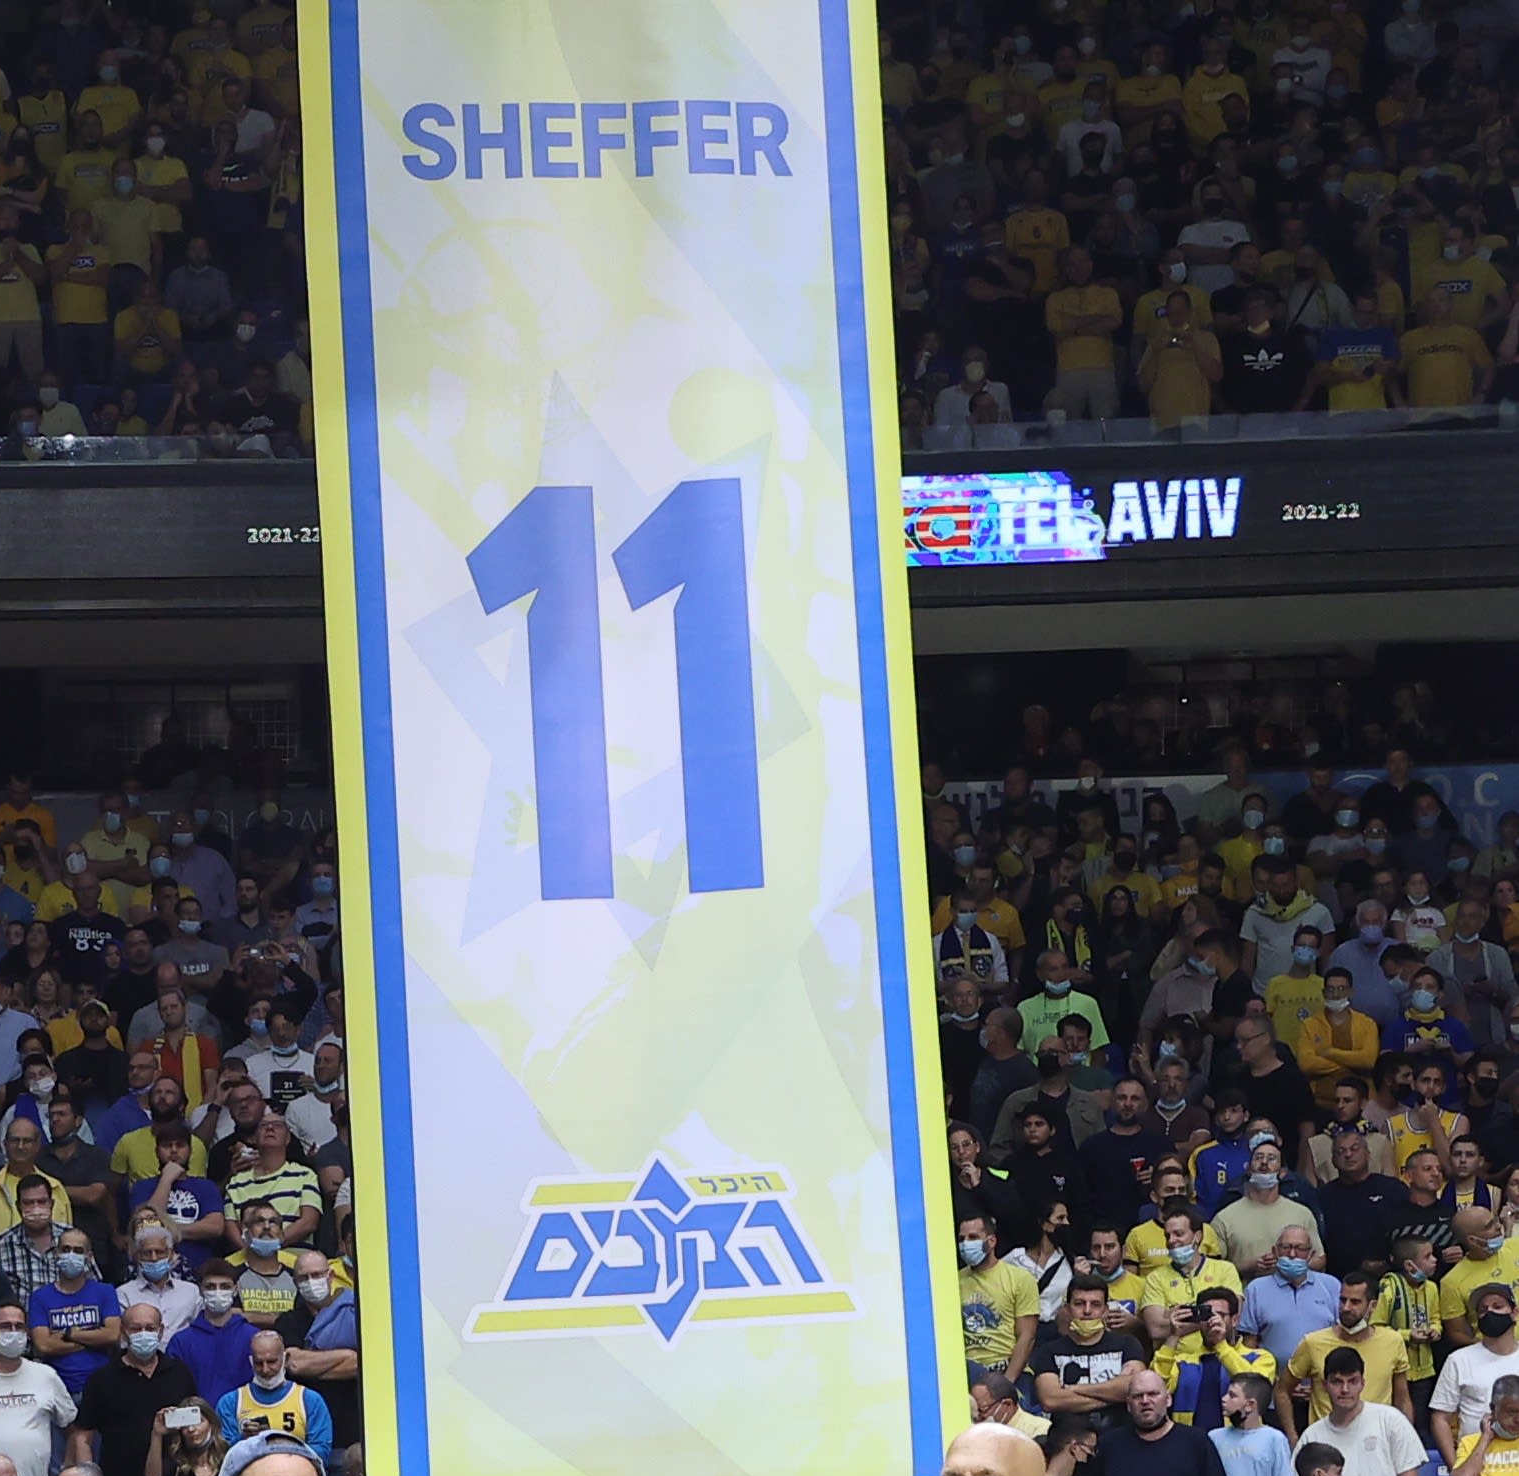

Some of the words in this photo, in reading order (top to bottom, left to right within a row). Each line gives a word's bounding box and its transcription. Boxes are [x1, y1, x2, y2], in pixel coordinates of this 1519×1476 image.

[402, 100, 794, 181] SHEFFER
[1106, 478, 1241, 543] AVIV
[1282, 503, 1361, 521] 2021-22
[247, 527, 320, 543] 2021-22
[465, 478, 765, 900] 11
[68, 927, 112, 940] Nautica
[699, 1175, 773, 1193] היכל
[52, 1311, 95, 1327] MACCABI
[283, 1412, 295, 1431] 5
